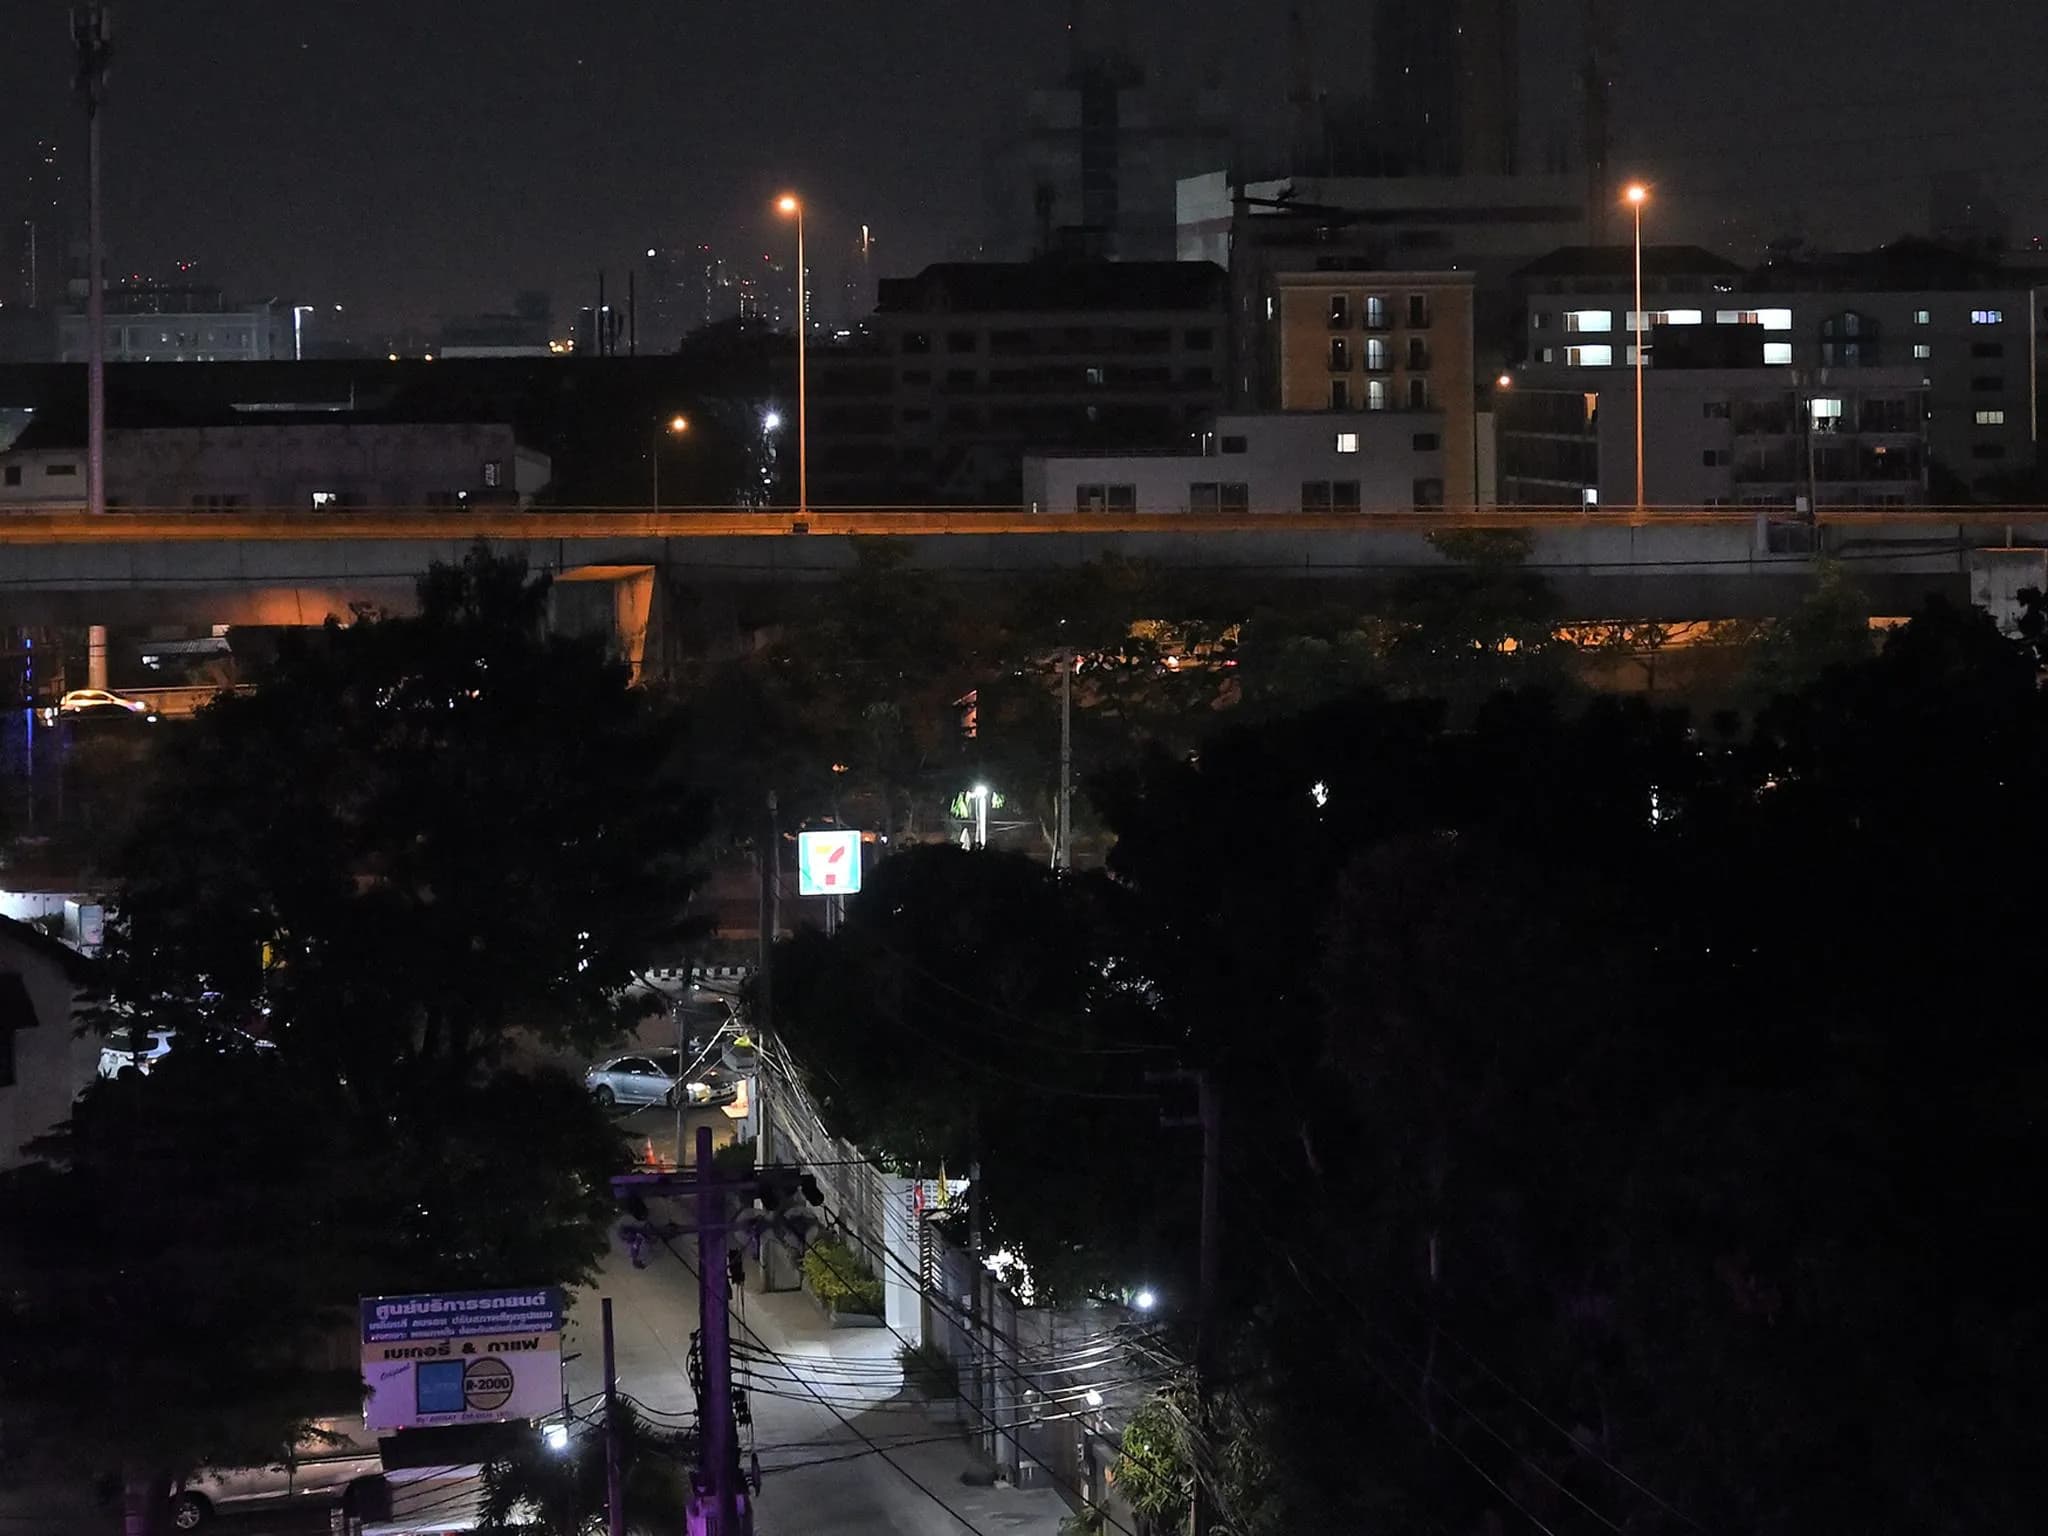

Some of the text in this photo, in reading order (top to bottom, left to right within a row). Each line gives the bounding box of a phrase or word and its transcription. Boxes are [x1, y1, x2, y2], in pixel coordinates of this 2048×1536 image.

[375, 1292, 547, 1320] ศูนย์บริการรถยนต์
[462, 1342, 476, 1354] &
[488, 1337, 539, 1352] กาแฟ
[466, 1378, 509, 1391] R-2000
